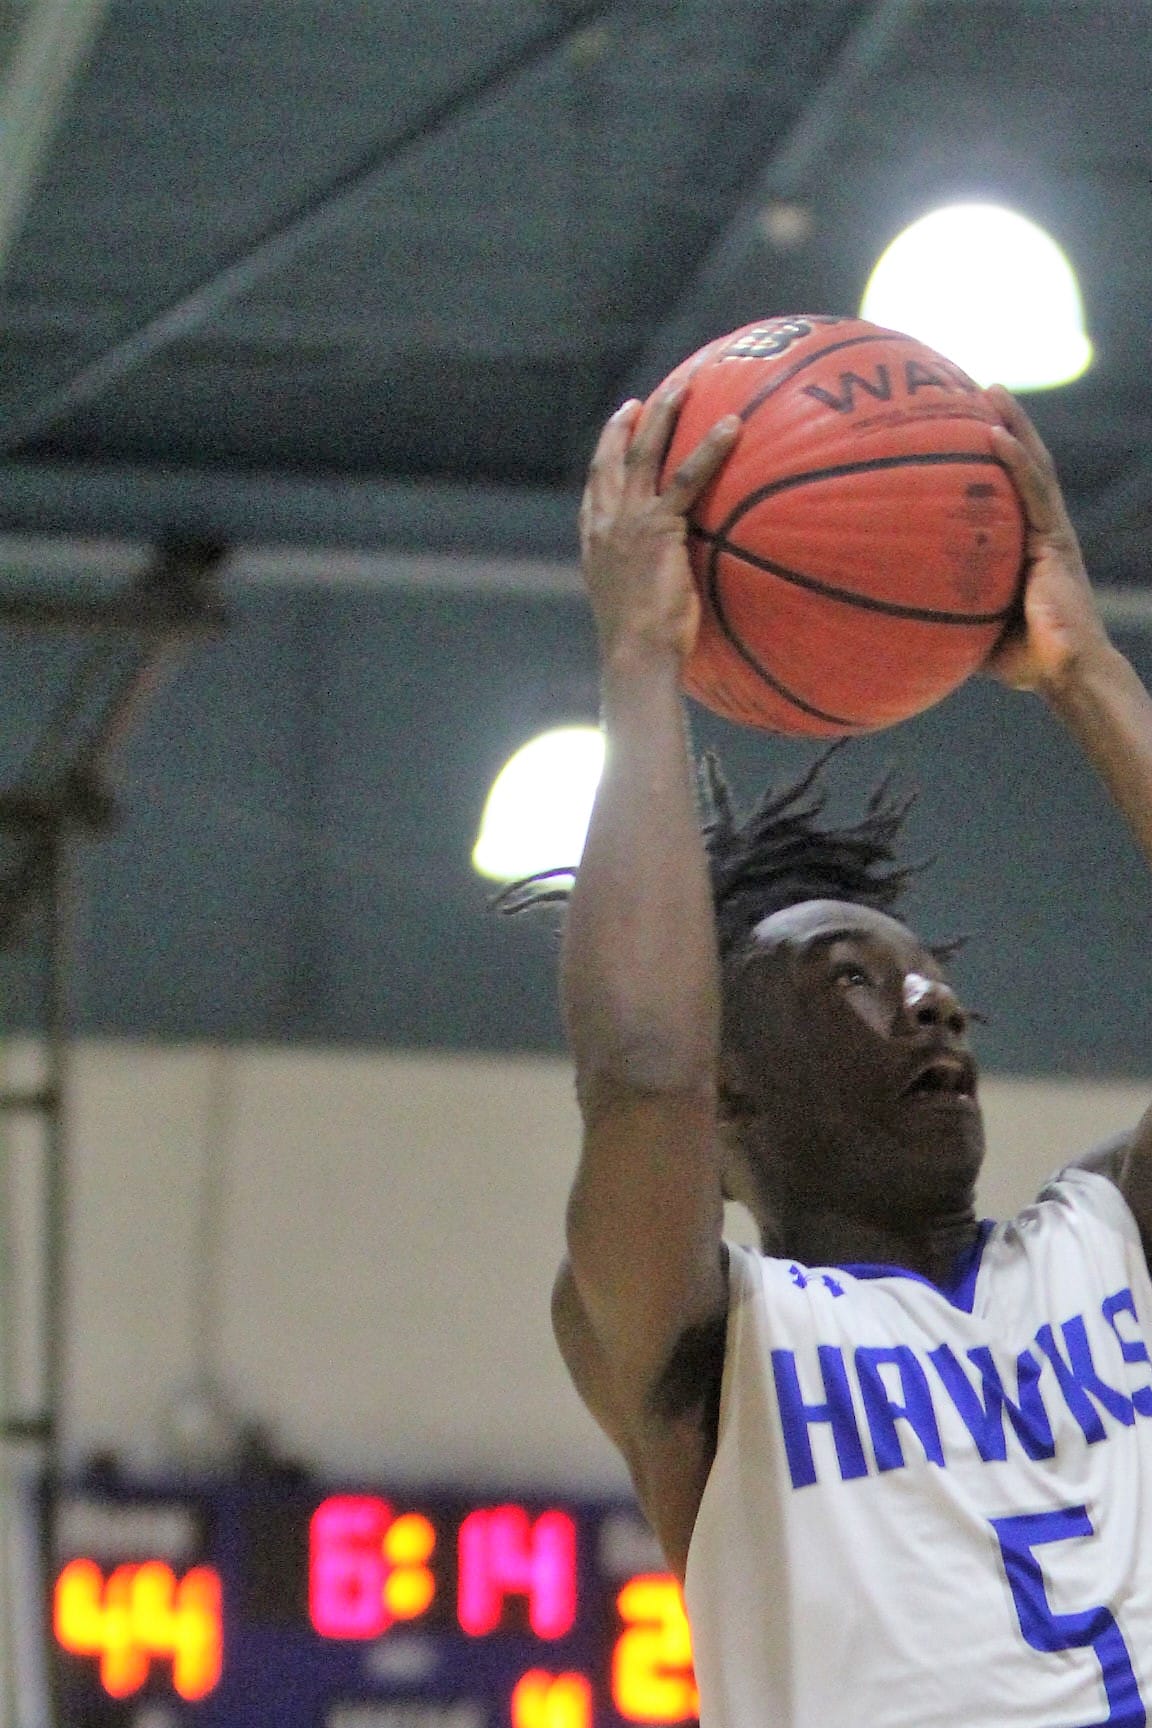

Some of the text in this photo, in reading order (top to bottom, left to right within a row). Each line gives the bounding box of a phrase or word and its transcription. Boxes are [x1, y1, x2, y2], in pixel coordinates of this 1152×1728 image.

[804, 358, 976, 414] WA
[54, 1558, 224, 1700] 44
[309, 1495, 578, 1640] 6:14
[611, 1572, 699, 1724] 2
